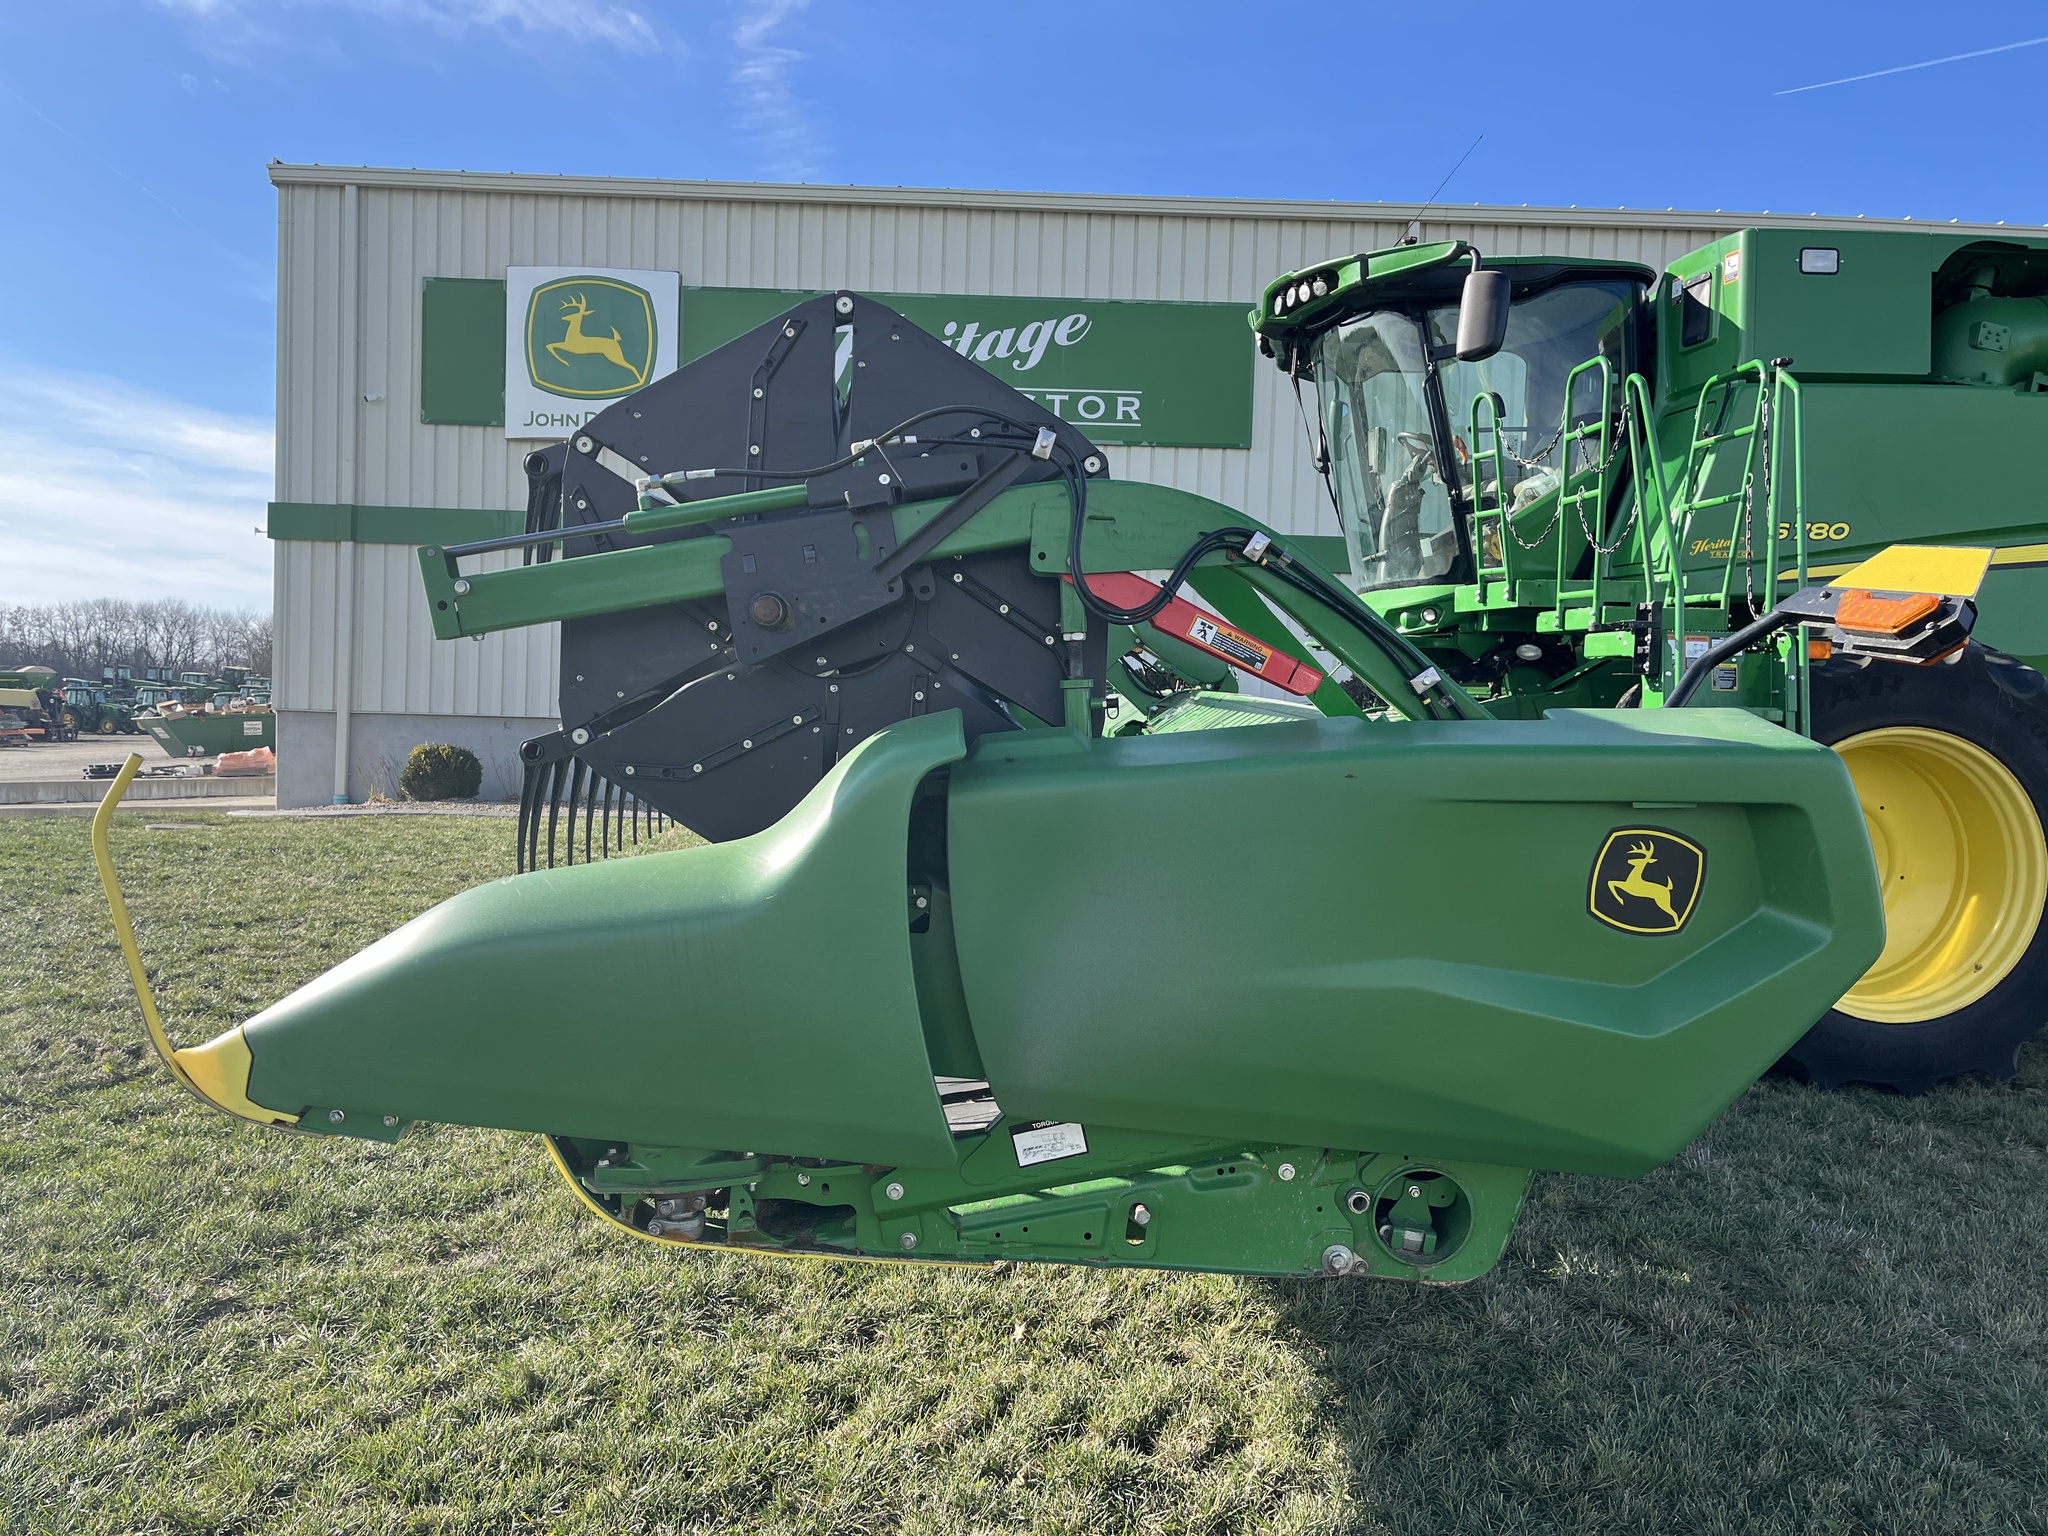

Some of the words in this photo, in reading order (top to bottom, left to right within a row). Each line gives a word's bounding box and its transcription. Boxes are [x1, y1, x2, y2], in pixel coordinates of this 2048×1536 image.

[1031, 393, 1141, 420] TOR
[523, 411, 579, 426] JOHN
[1690, 537, 1745, 556] Heritae
[1234, 634, 1263, 653] WARNING
[1032, 1120, 1059, 1129] TORQU
